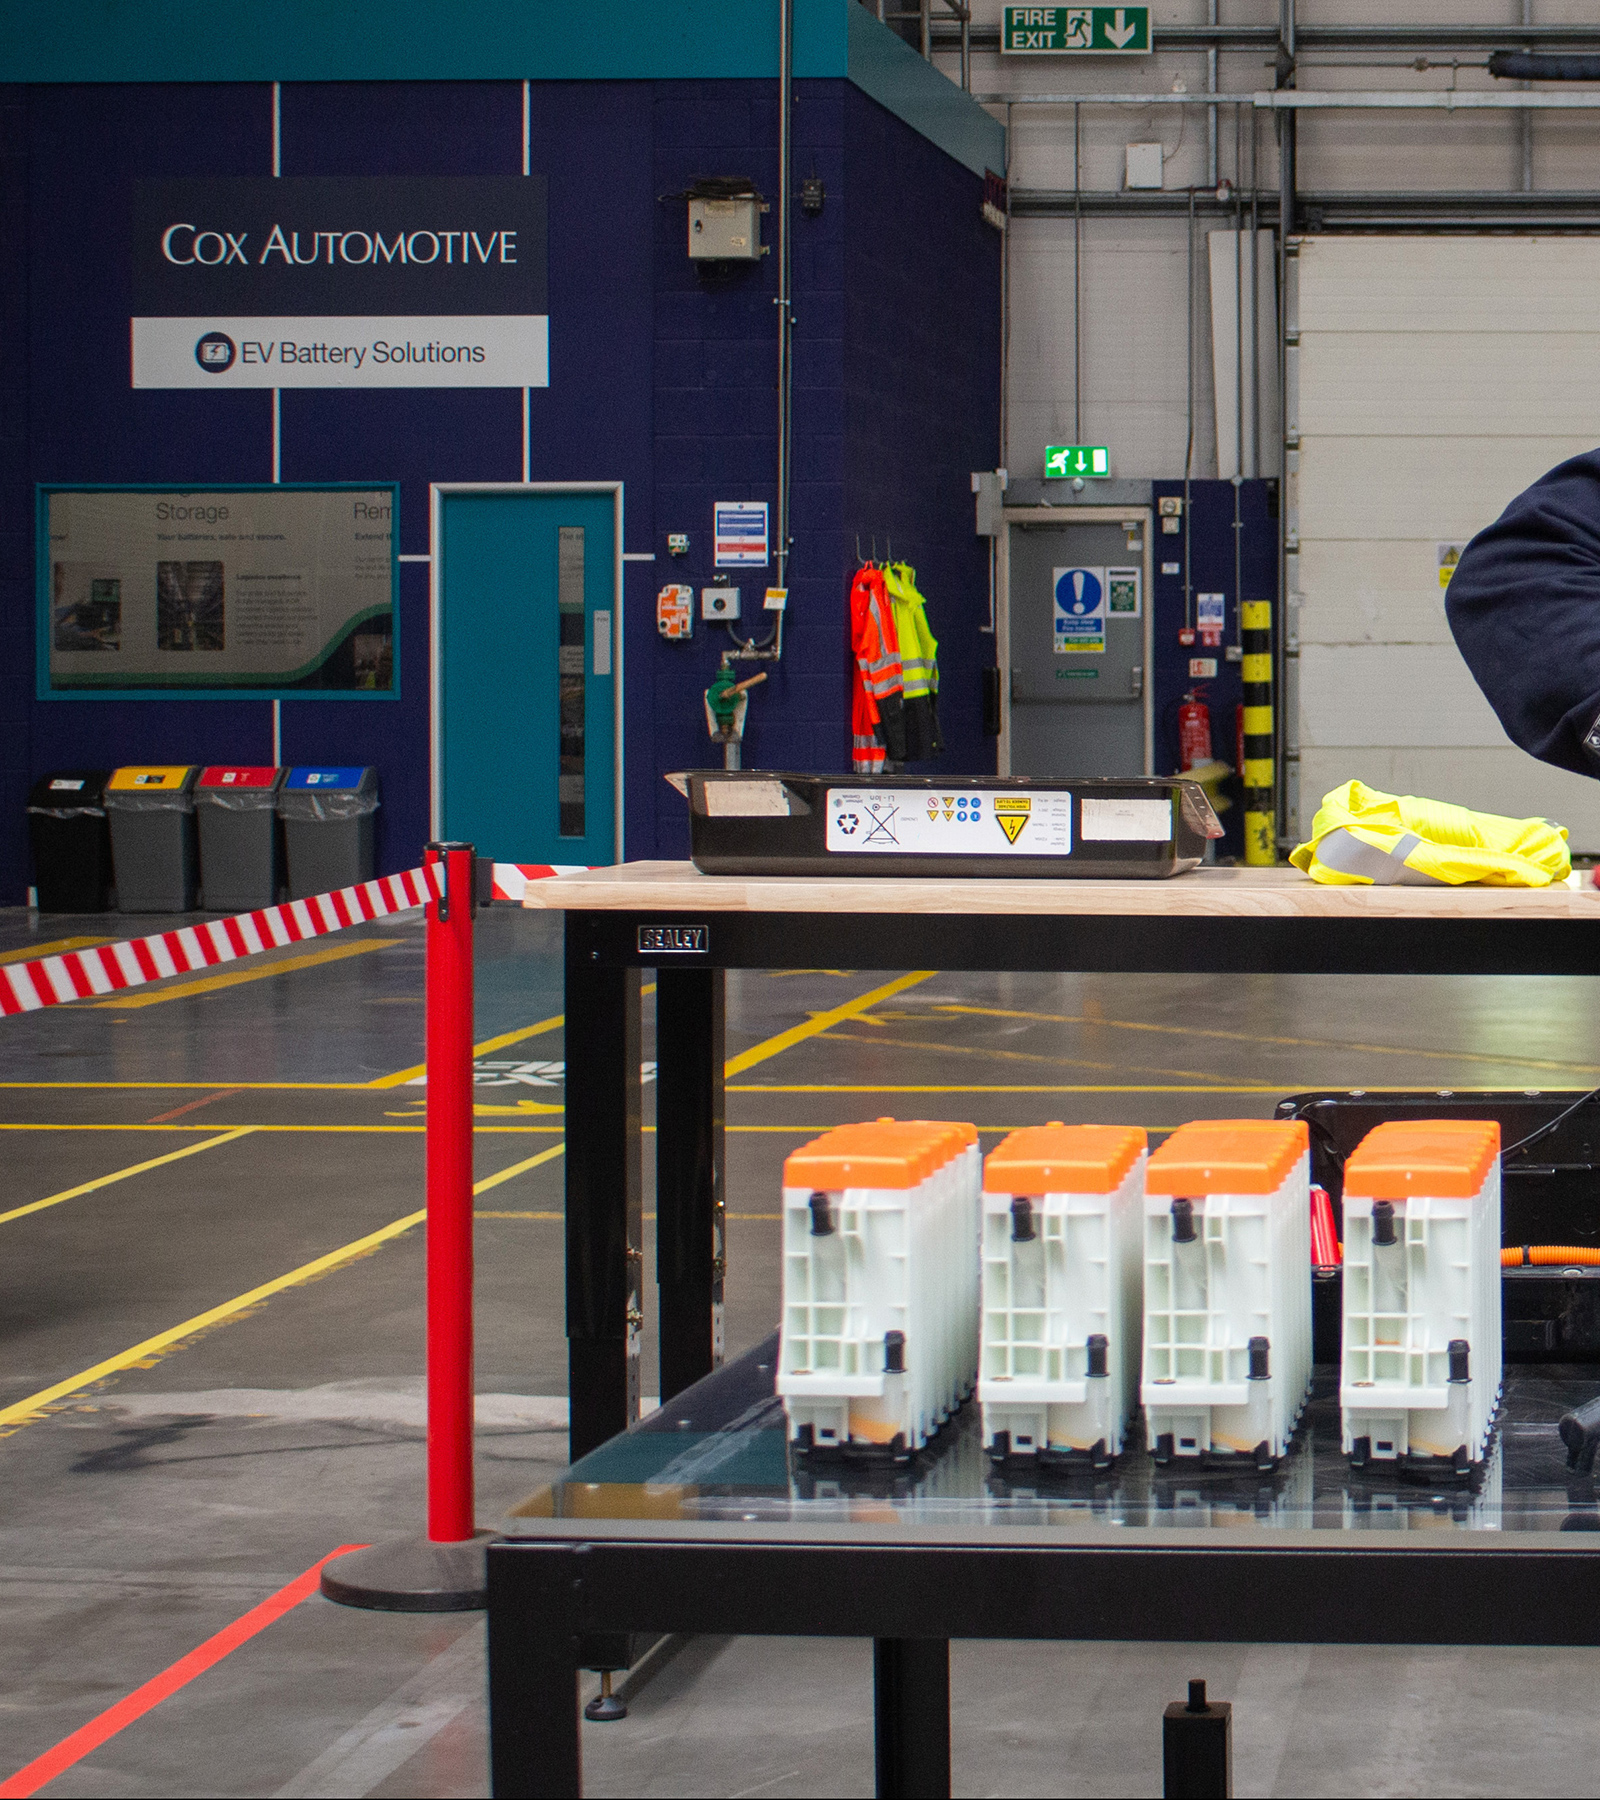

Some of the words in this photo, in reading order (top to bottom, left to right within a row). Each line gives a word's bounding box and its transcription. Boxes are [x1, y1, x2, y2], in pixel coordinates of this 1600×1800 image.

[1012, 9, 1057, 26] FIRE
[1012, 31, 1057, 48] EXIT
[259, 223, 518, 266] AUTOMOTIVE
[241, 342, 275, 363] EV
[280, 341, 366, 368] Battery
[373, 341, 485, 364] Solutions
[156, 502, 230, 524] Storage
[642, 929, 702, 949] SEALEY
